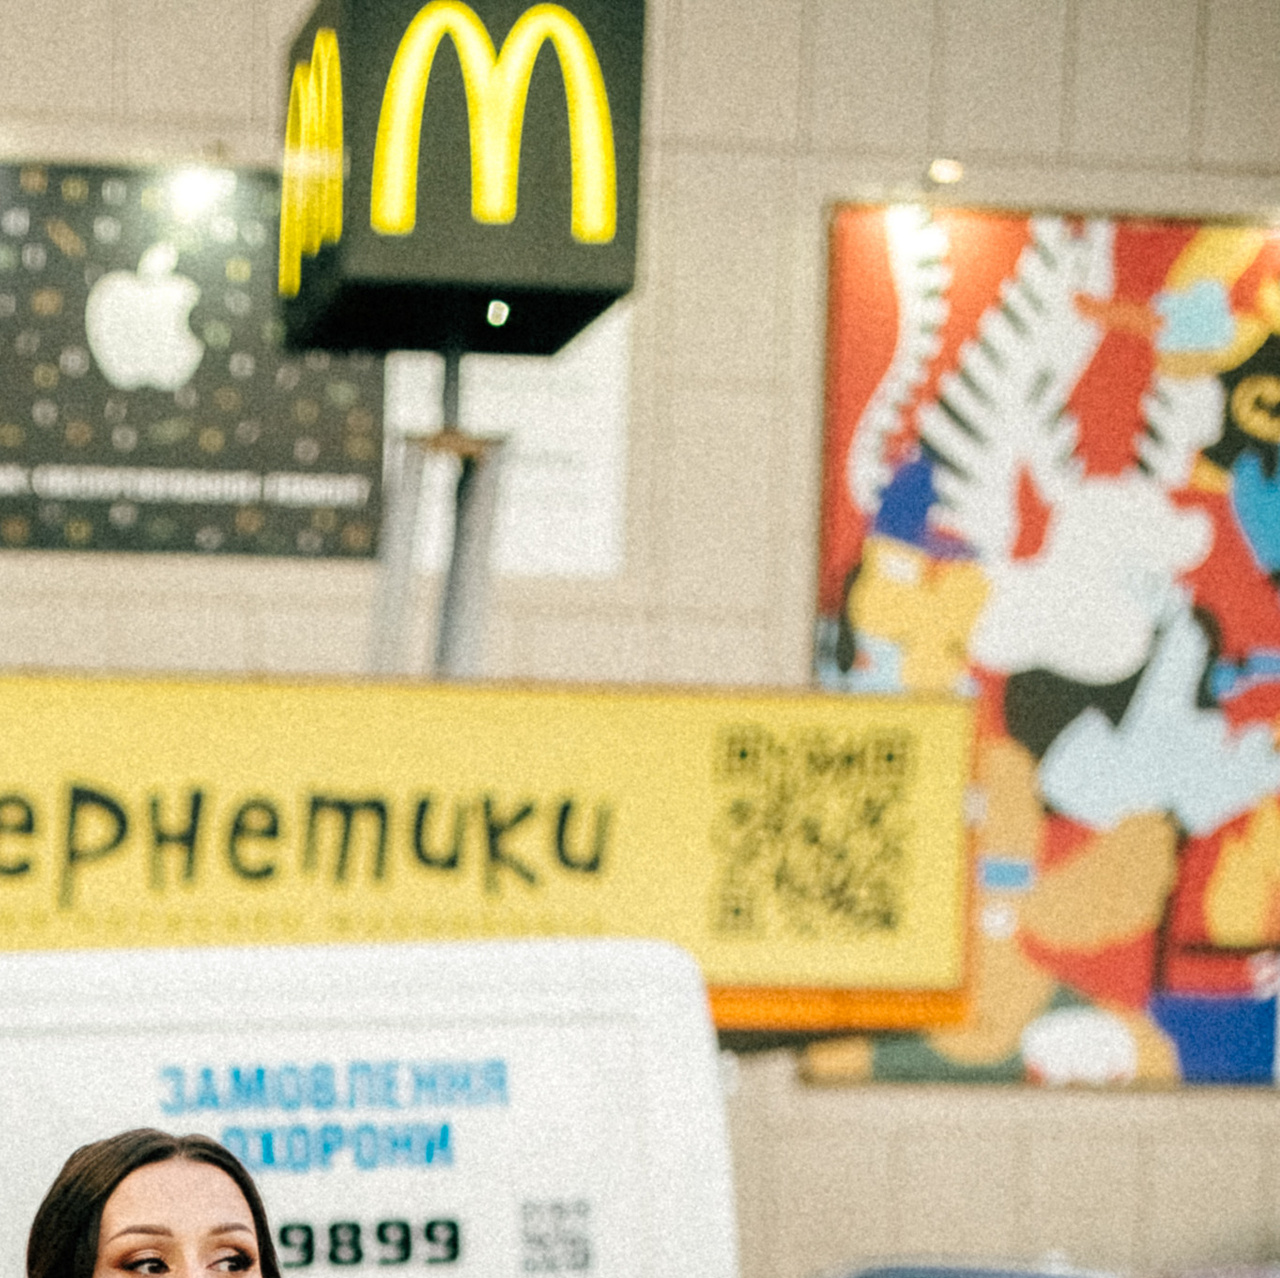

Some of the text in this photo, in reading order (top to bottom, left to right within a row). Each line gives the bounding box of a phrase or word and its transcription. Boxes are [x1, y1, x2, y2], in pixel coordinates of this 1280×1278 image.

[370, 0, 618, 244] M
[158, 1058, 509, 1115] ЗАМОВЛЕННЯ
[278, 1219, 460, 1269] 9899
